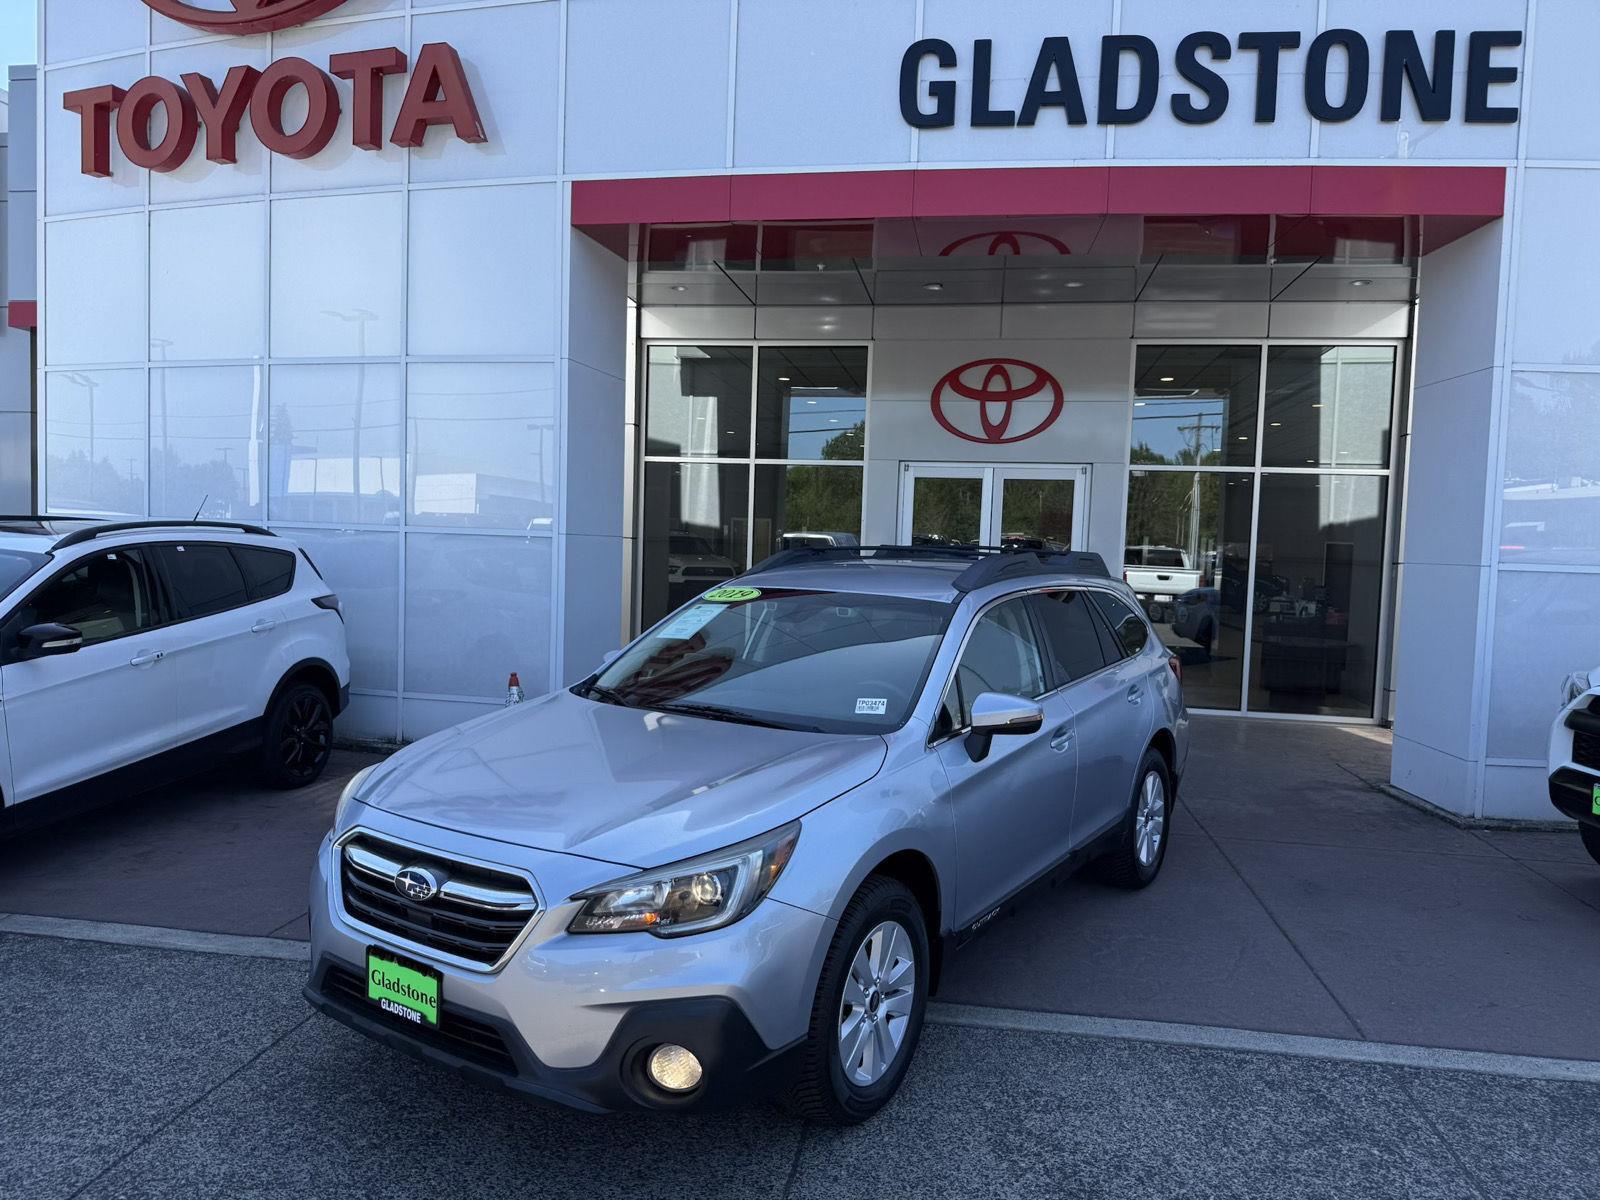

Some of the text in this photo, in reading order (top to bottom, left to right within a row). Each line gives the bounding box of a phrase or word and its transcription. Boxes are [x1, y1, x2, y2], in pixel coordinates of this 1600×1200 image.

[898, 29, 1523, 128] GLADSTONE
[63, 42, 488, 178] TOYOTA
[709, 589, 754, 599] 2019
[371, 969, 437, 1008] Gladstone
[380, 998, 422, 1024] GLADSTONE
